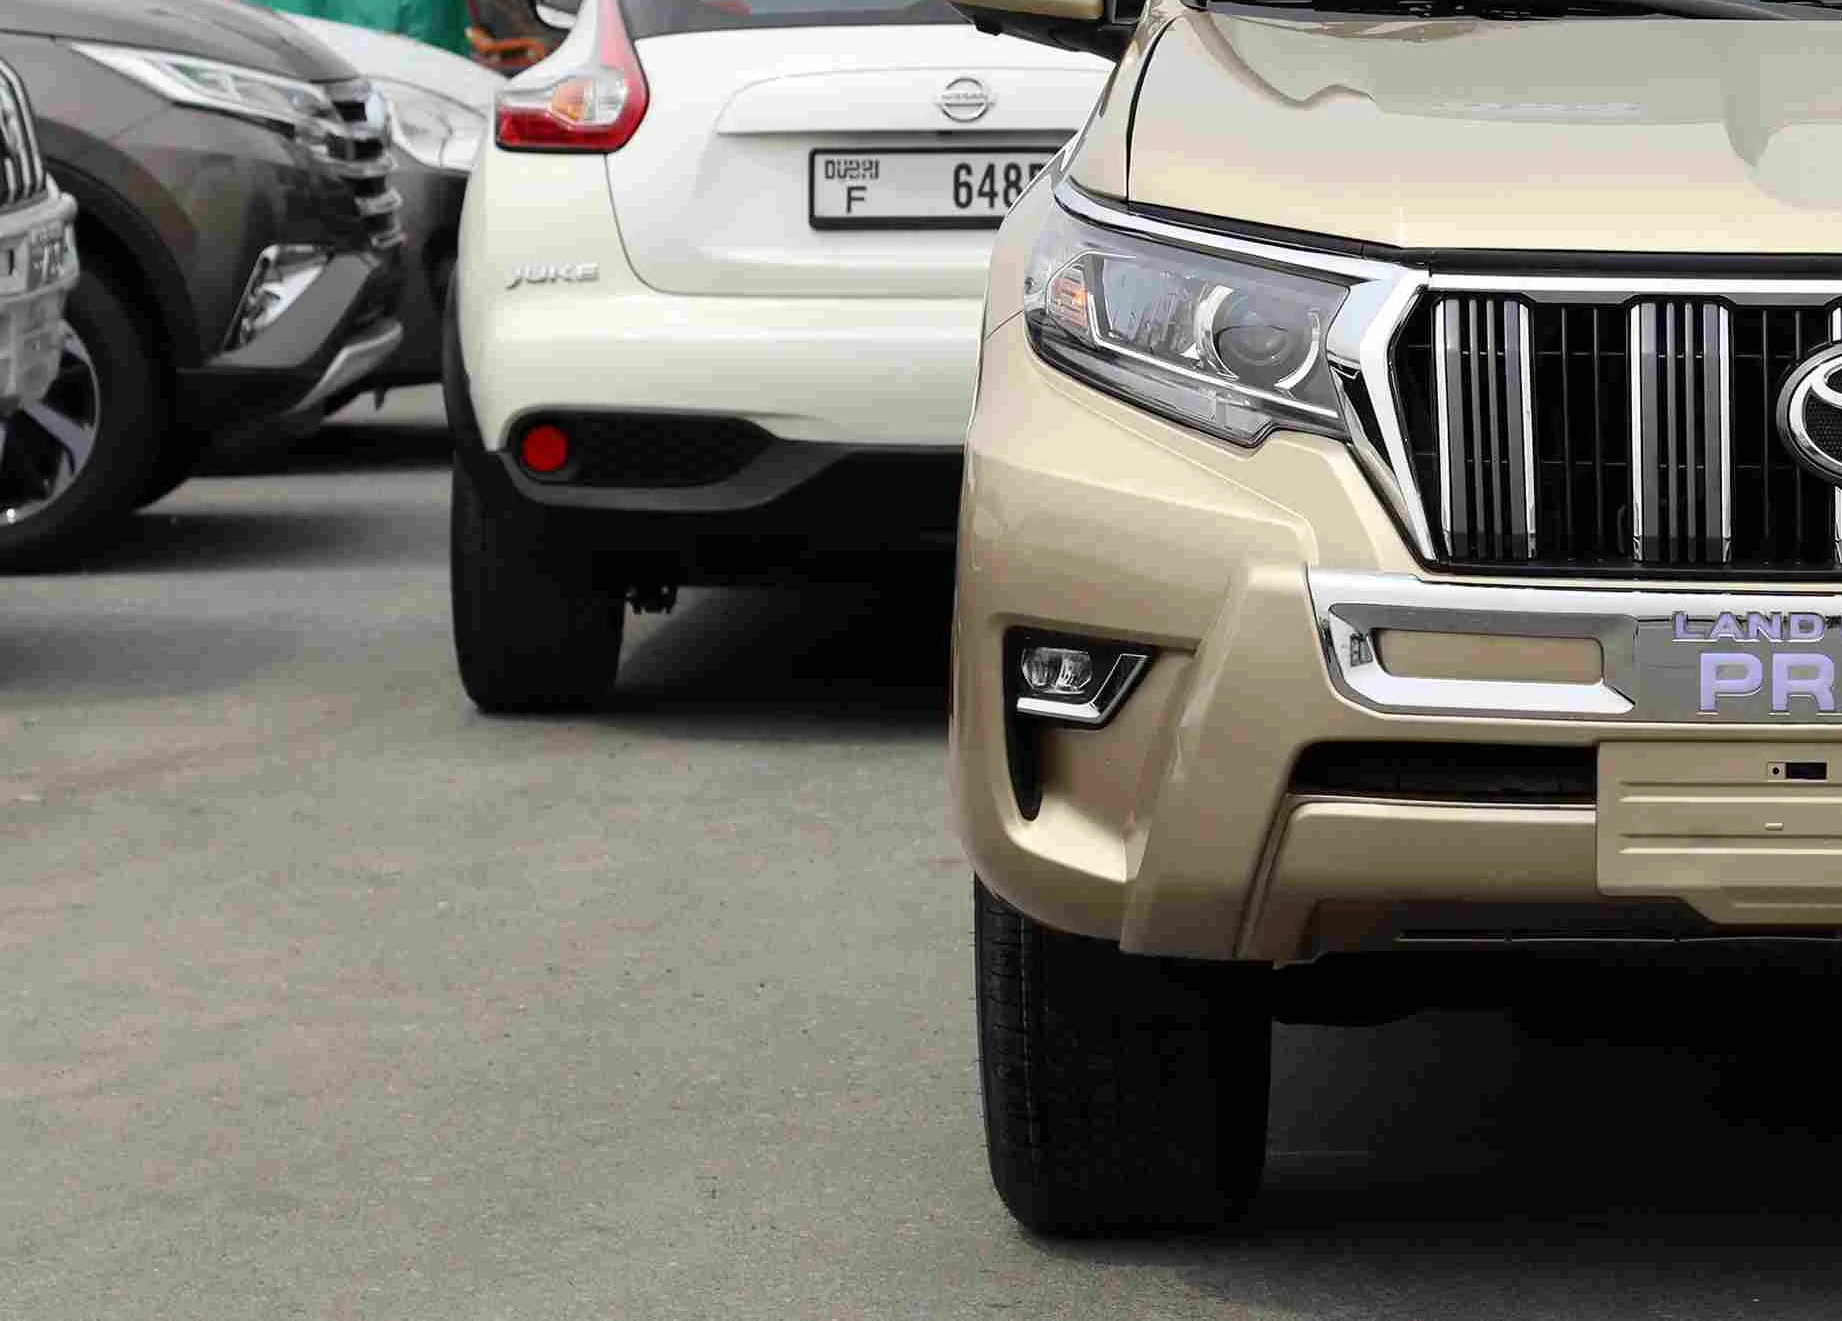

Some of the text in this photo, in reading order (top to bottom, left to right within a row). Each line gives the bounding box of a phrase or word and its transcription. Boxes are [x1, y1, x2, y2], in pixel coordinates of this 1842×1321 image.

[846, 185, 867, 213] F
[504, 260, 600, 291] JUKE
[1671, 611, 1825, 642] LAND
